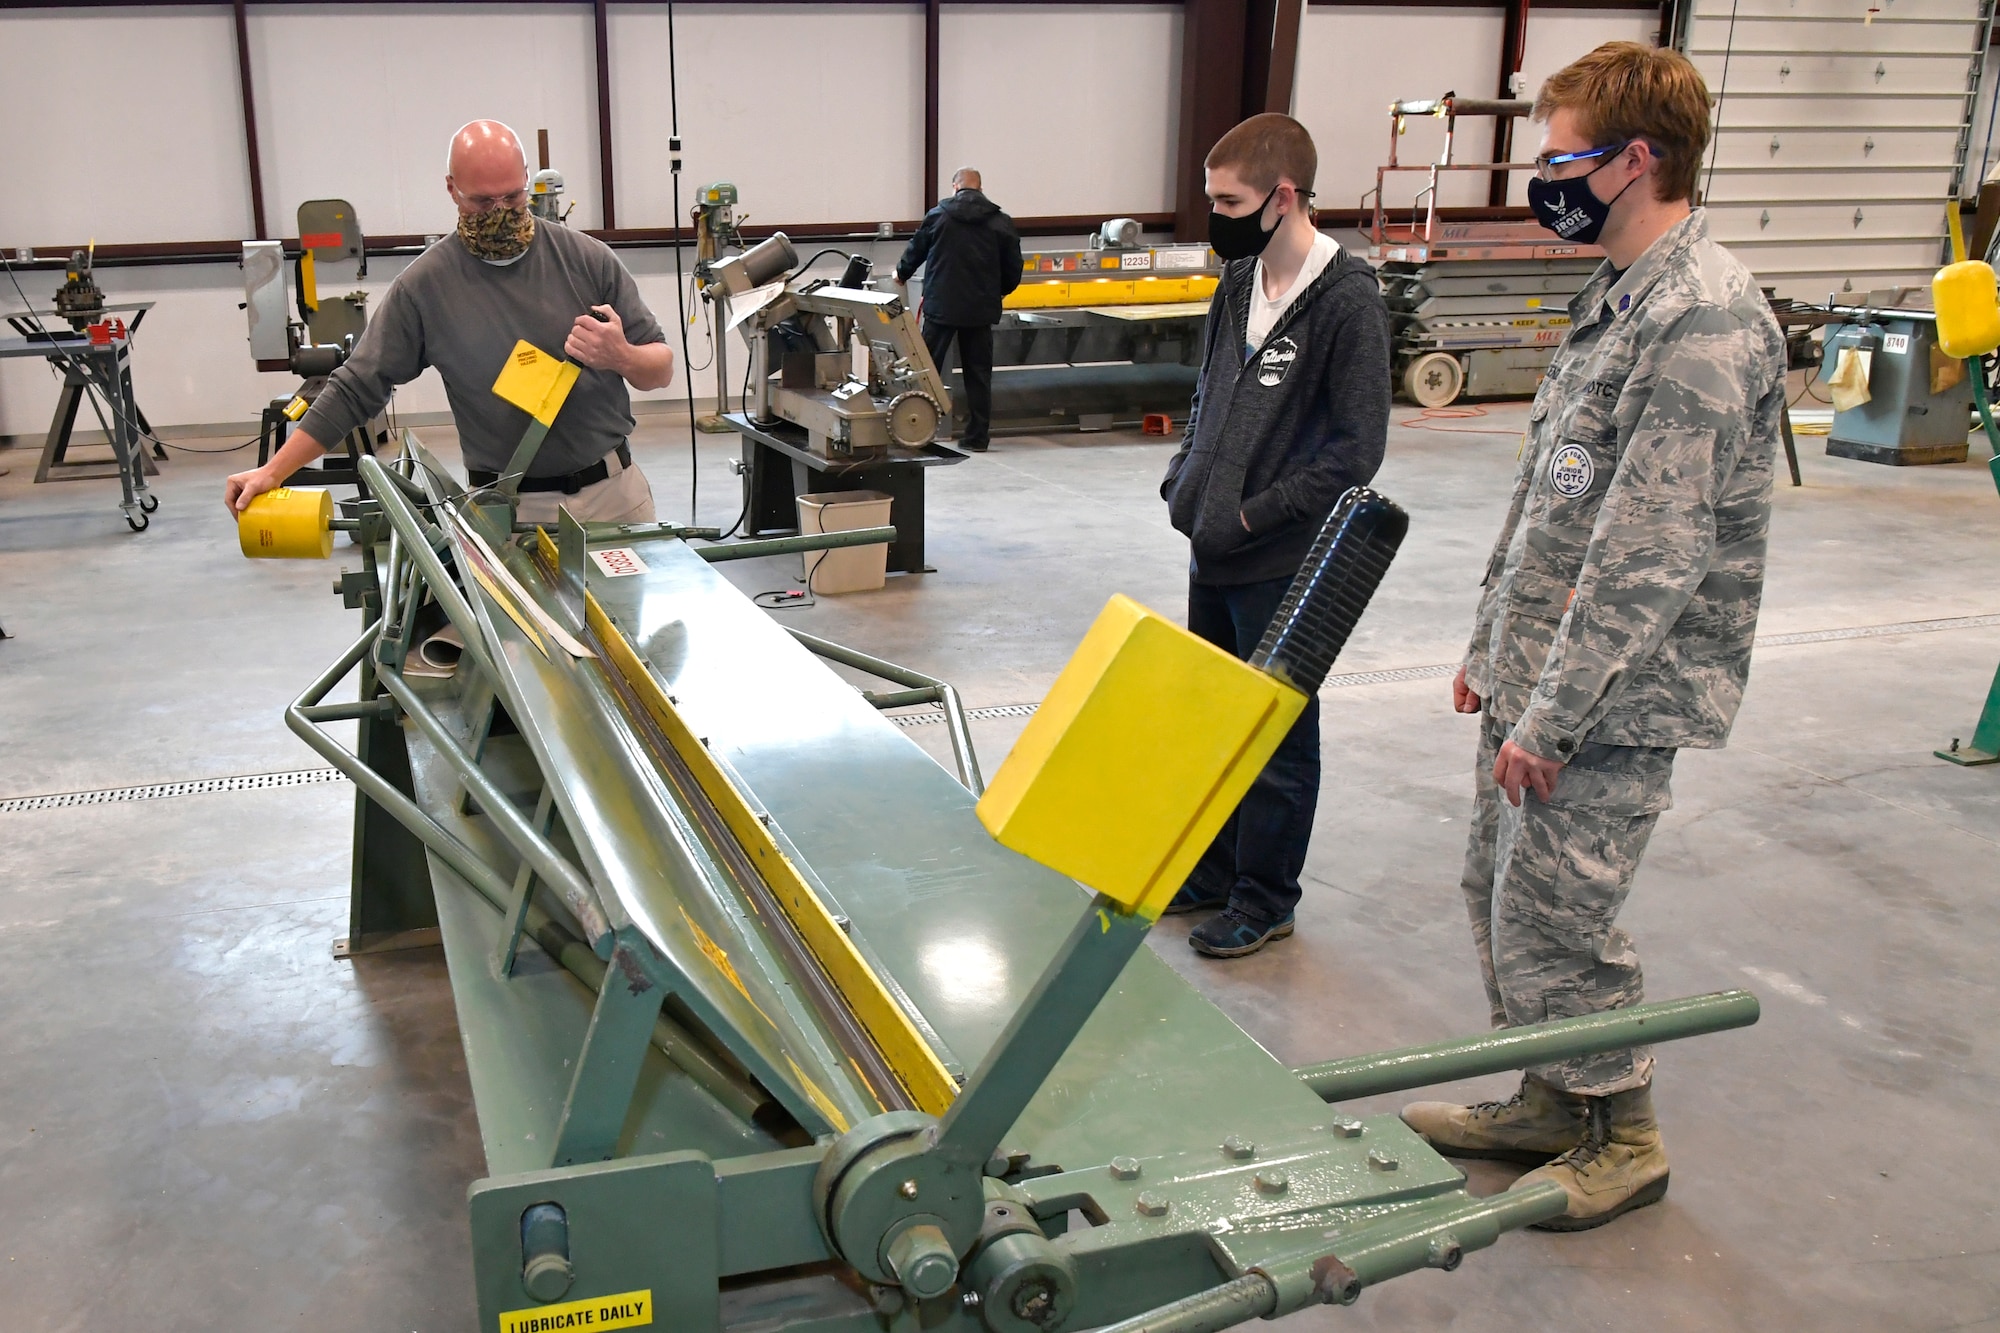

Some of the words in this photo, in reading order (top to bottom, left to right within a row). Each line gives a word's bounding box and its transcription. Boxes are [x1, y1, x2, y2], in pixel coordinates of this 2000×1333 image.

[1555, 210, 1587, 233] JROTC
[1123, 256, 1149, 266] 12235
[1886, 337, 1905, 348] 8740
[1260, 348, 1296, 366] Telluride
[1558, 452, 1568, 464] AIR
[1570, 451, 1587, 468] FORCE
[1559, 466, 1582, 474] JUNIOR
[1556, 472, 1585, 484] ROTC
[601, 1302, 644, 1321] DAILY
